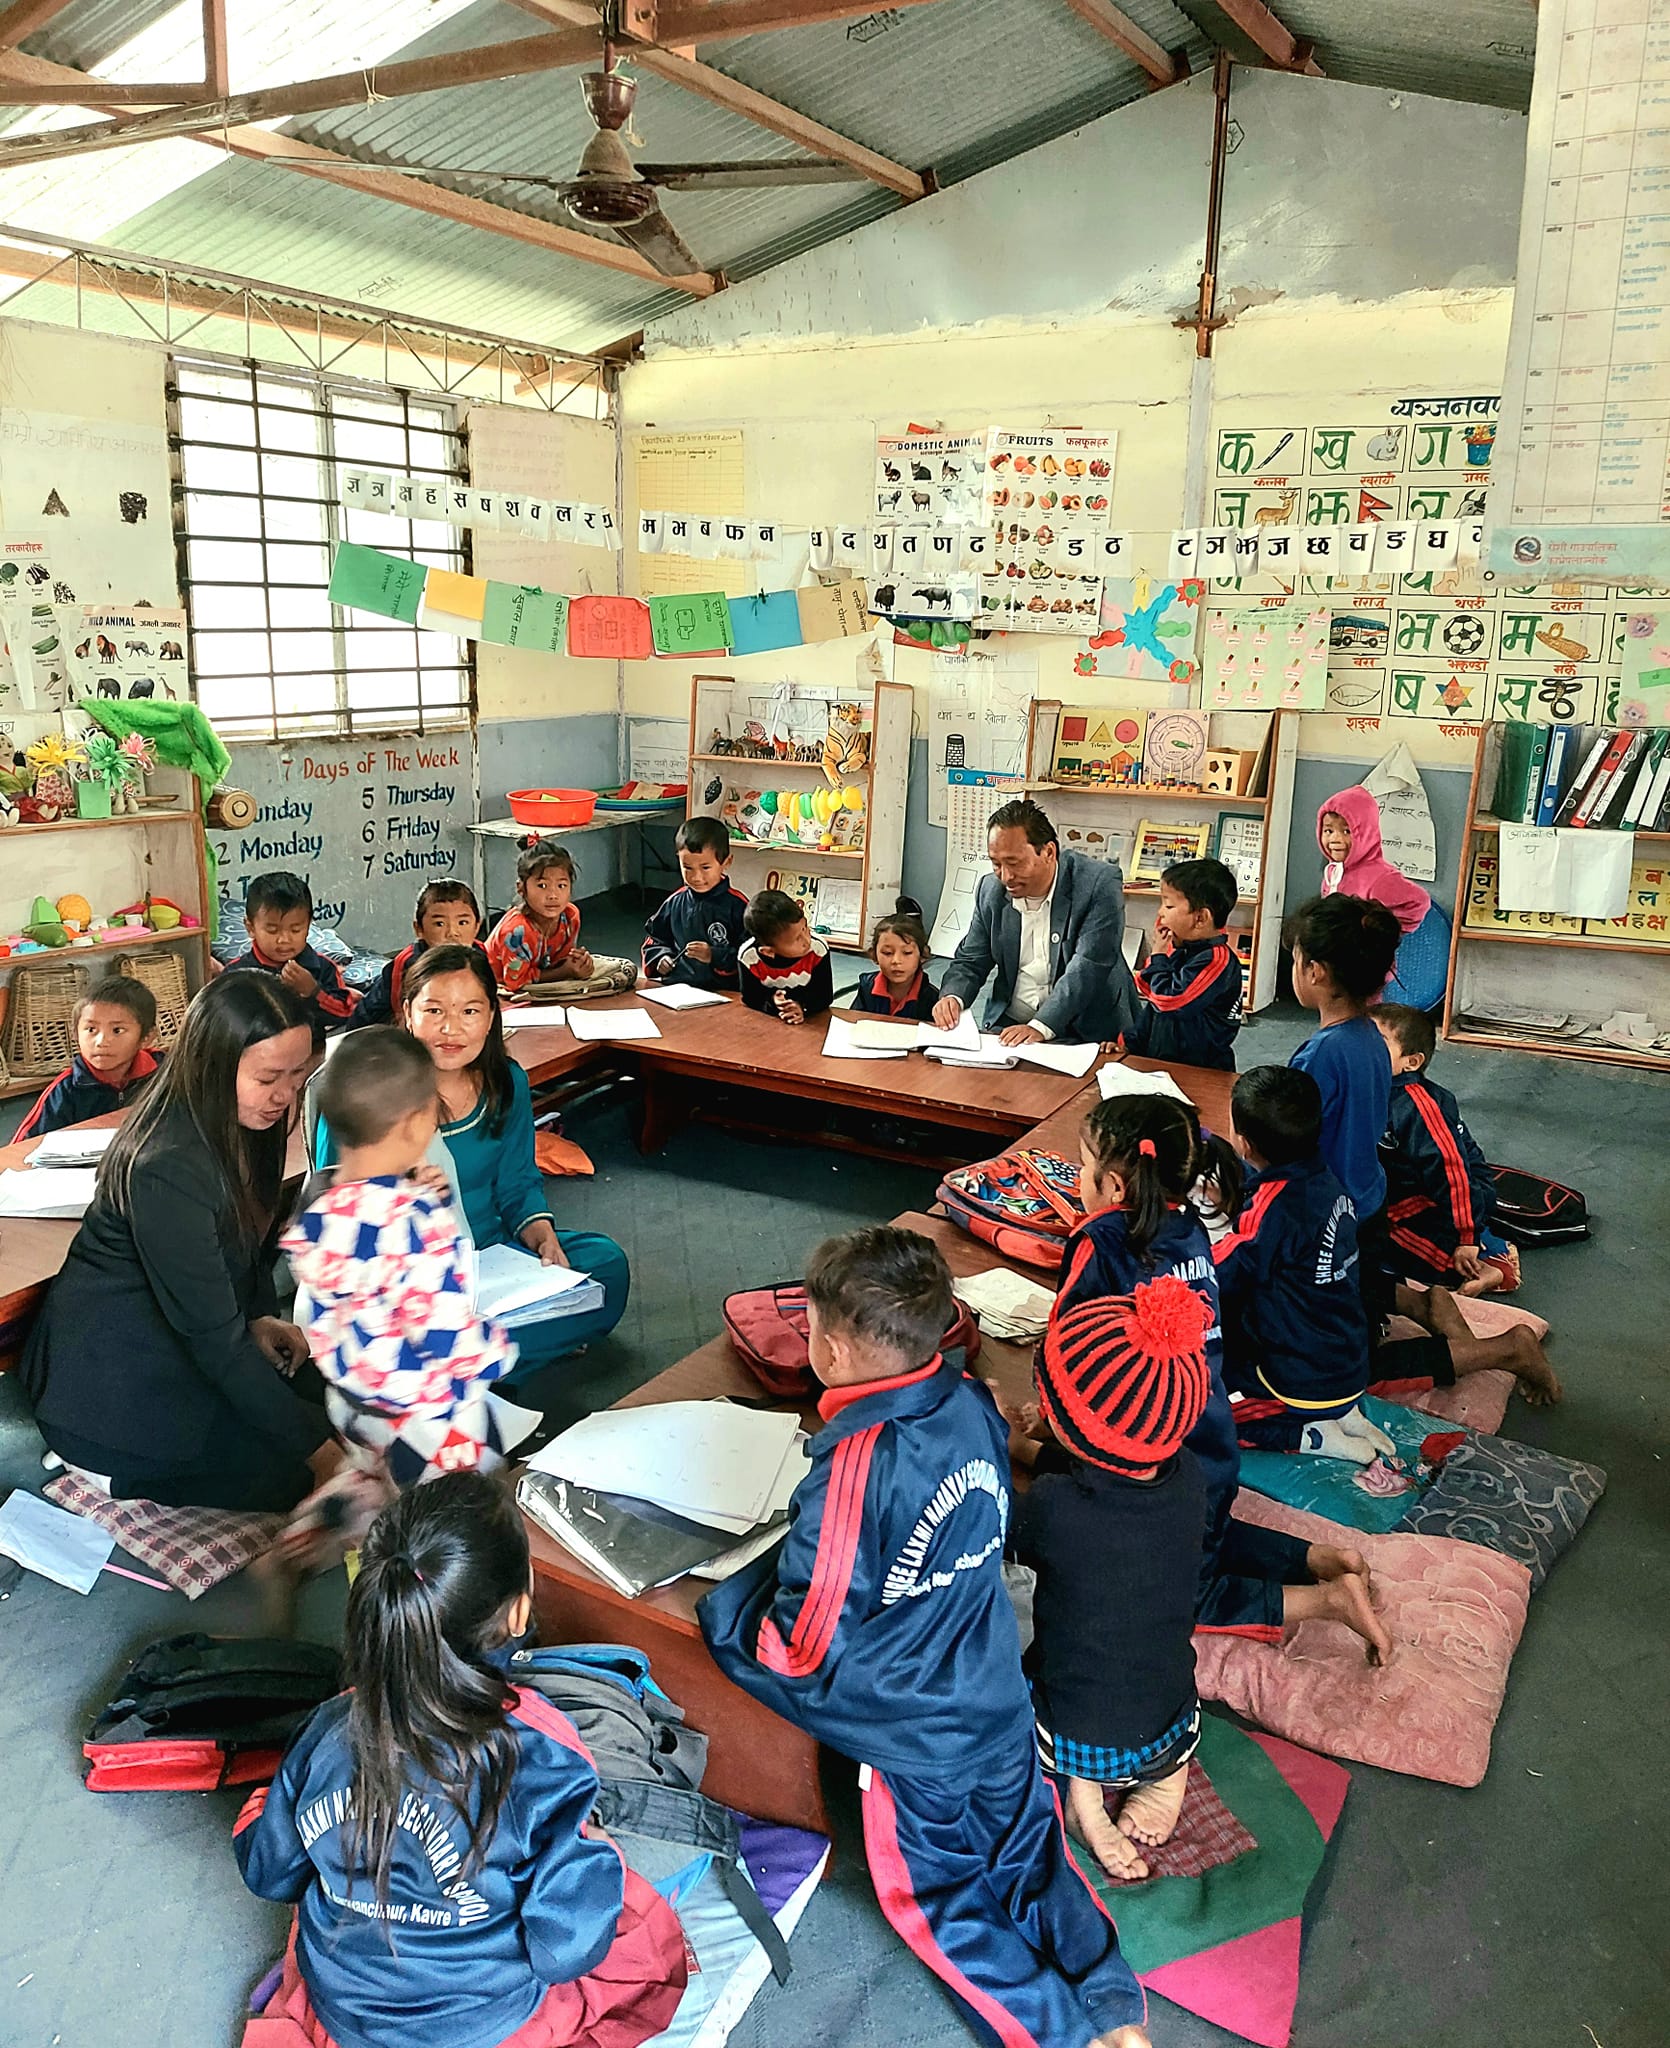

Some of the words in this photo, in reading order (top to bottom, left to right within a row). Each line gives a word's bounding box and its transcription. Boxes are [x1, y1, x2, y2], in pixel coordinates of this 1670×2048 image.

[897, 440, 944, 451] DOMESTIC
[948, 437, 983, 448] ANIMAL
[1008, 436, 1054, 447] FRUITS
[1219, 432, 1256, 475] क
[1313, 430, 1356, 472] ख
[1414, 426, 1453, 468] ग
[346, 476, 360, 494] ज्ञ
[371, 481, 385, 498] त्र
[425, 487, 438, 505] ह
[453, 491, 467, 508] स
[481, 497, 492, 513] ष
[505, 501, 519, 518] श
[530, 504, 541, 520] व
[556, 505, 571, 522] ल
[584, 512, 597, 529] र
[1218, 492, 1251, 528] ज
[642, 518, 657, 534] म
[672, 520, 687, 537] भ
[700, 520, 712, 536] ब
[725, 525, 746, 541] फ
[759, 526, 775, 542] न
[842, 532, 857, 550] द
[873, 533, 887, 549] थ
[902, 536, 917, 553] त
[933, 536, 953, 553] ण
[970, 536, 986, 553] ढ
[1068, 539, 1085, 556] ड
[1104, 537, 1123, 555] ठ
[1177, 539, 1193, 556] ट
[1205, 536, 1227, 554] ञ
[1267, 536, 1291, 556] ज
[1306, 537, 1330, 556] छ
[1349, 533, 1367, 550] च
[1386, 530, 1406, 550] ङ
[1427, 530, 1448, 549] घ
[105, 616, 136, 627] ANIMAL
[1399, 613, 1441, 654] भ
[1502, 615, 1543, 655] म
[1394, 675, 1426, 715] ष
[1498, 678, 1538, 720] स
[282, 759, 294, 781] 7
[303, 757, 349, 785] Days
[384, 750, 410, 772] The
[416, 747, 460, 769] Week
[254, 796, 314, 825] unday
[362, 787, 375, 810] 5
[387, 783, 456, 807] Thursday
[362, 820, 376, 844] 6
[387, 815, 440, 842] Friday
[215, 841, 231, 867] 2
[240, 831, 323, 864] Monday
[363, 854, 375, 879] 7
[384, 845, 456, 876] Saturday
[217, 880, 230, 900] 3
[796, 875, 809, 897] 3
[809, 876, 820, 899] 4
[1473, 889, 1488, 905] ट
[1638, 890, 1660, 907] ल
[1314, 1250, 1333, 1285] SHREE
[897, 1518, 934, 1568] LAXMI
[296, 1796, 333, 1850] LAXMI
[410, 1903, 452, 1927] Kavre
